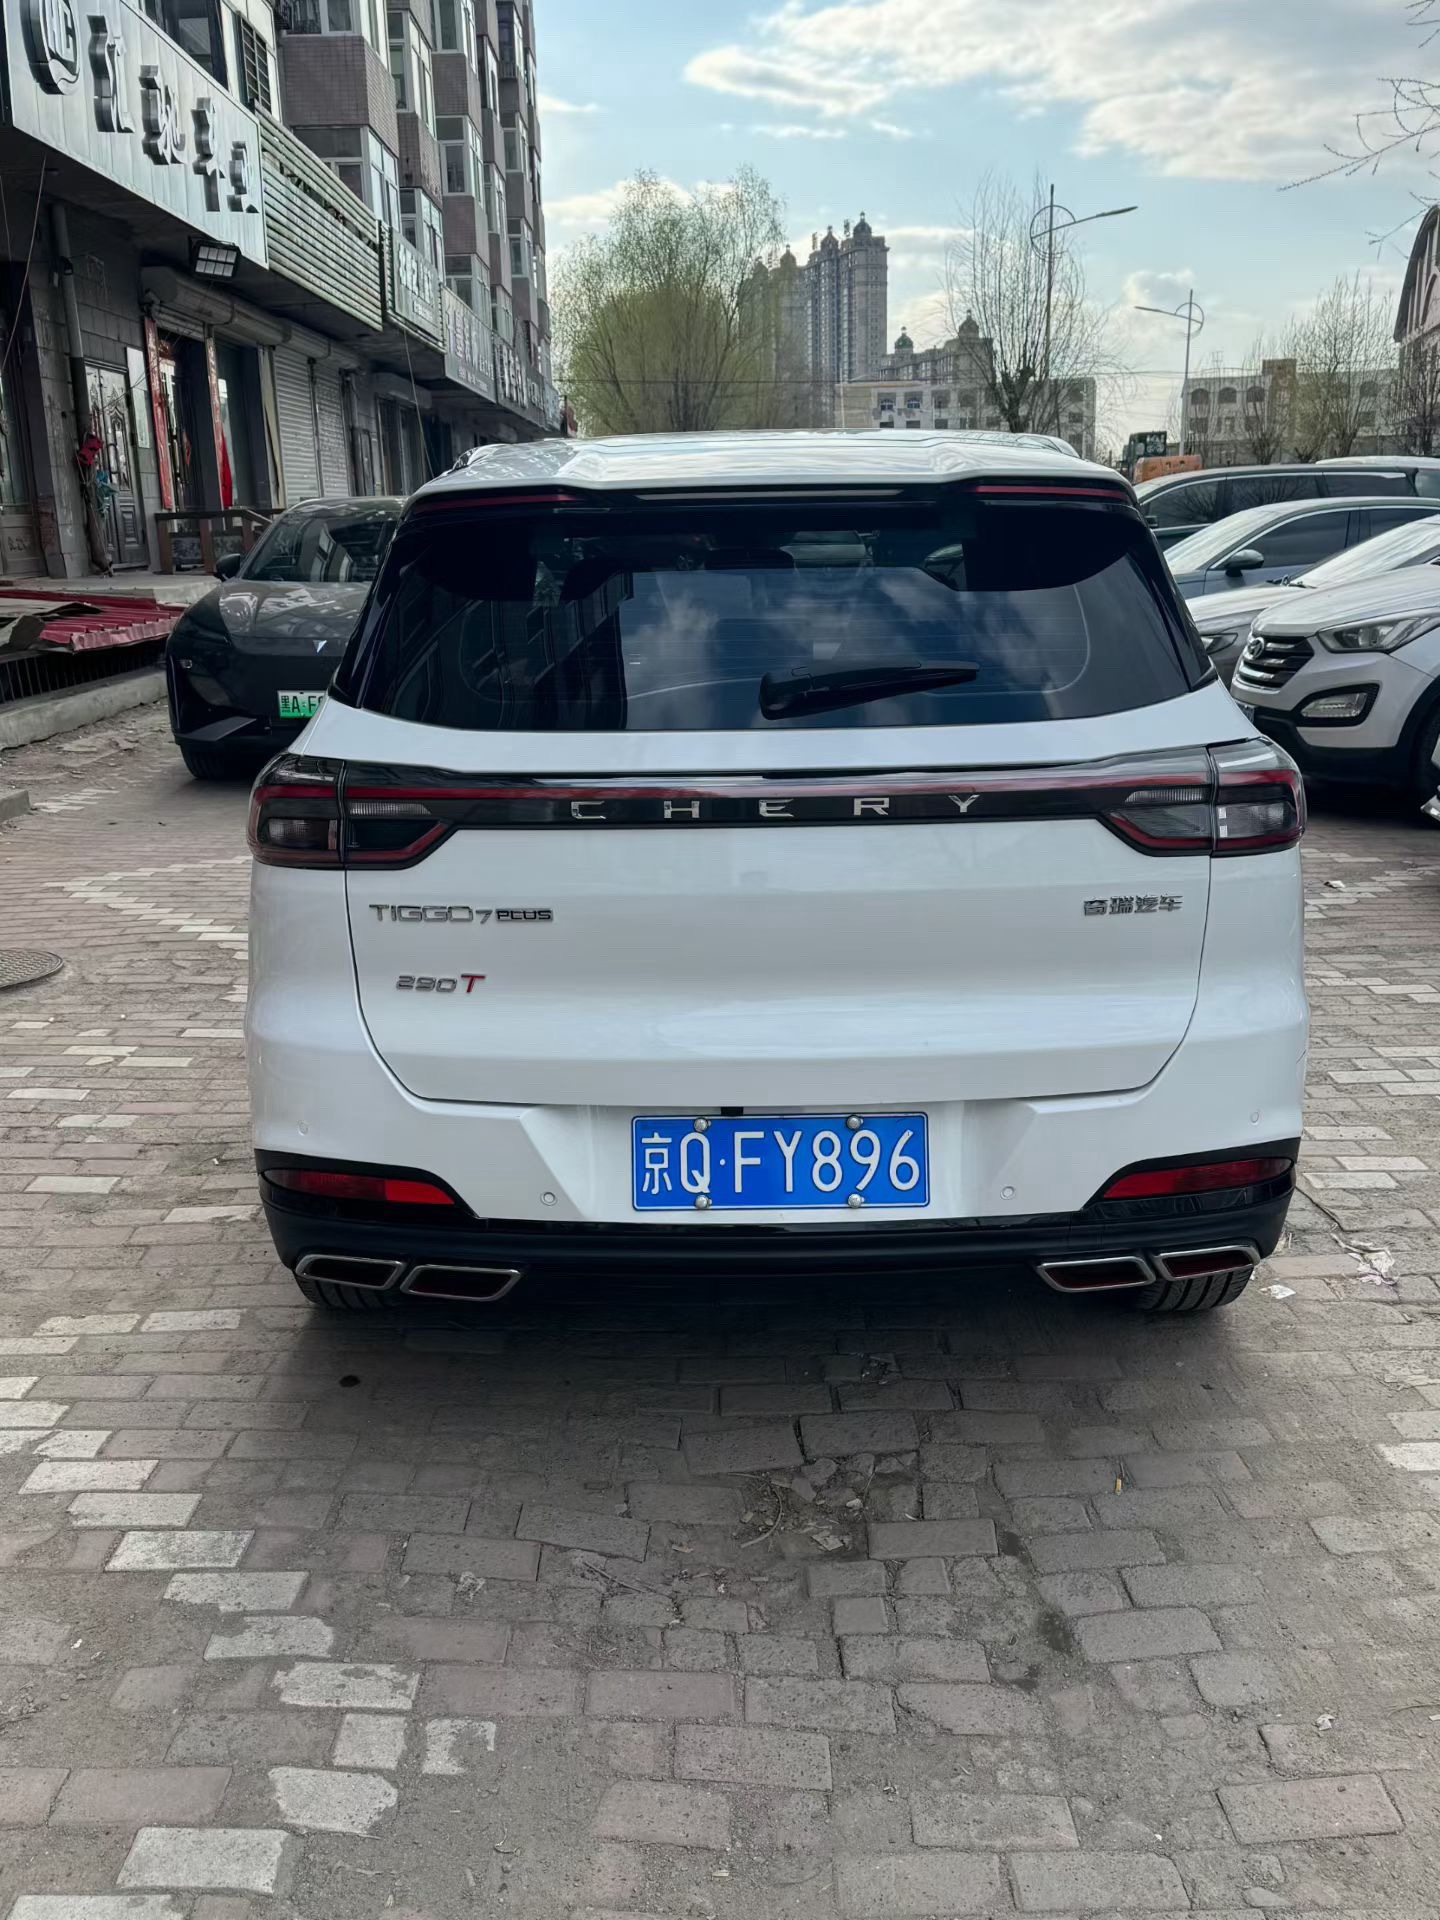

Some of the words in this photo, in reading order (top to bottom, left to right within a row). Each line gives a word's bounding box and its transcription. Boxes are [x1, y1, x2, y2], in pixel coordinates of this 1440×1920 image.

[571, 794, 980, 820] CHERY
[1083, 894, 1183, 917] 奇瑞汽车
[641, 1129, 920, 1195] 京Q·FY896
